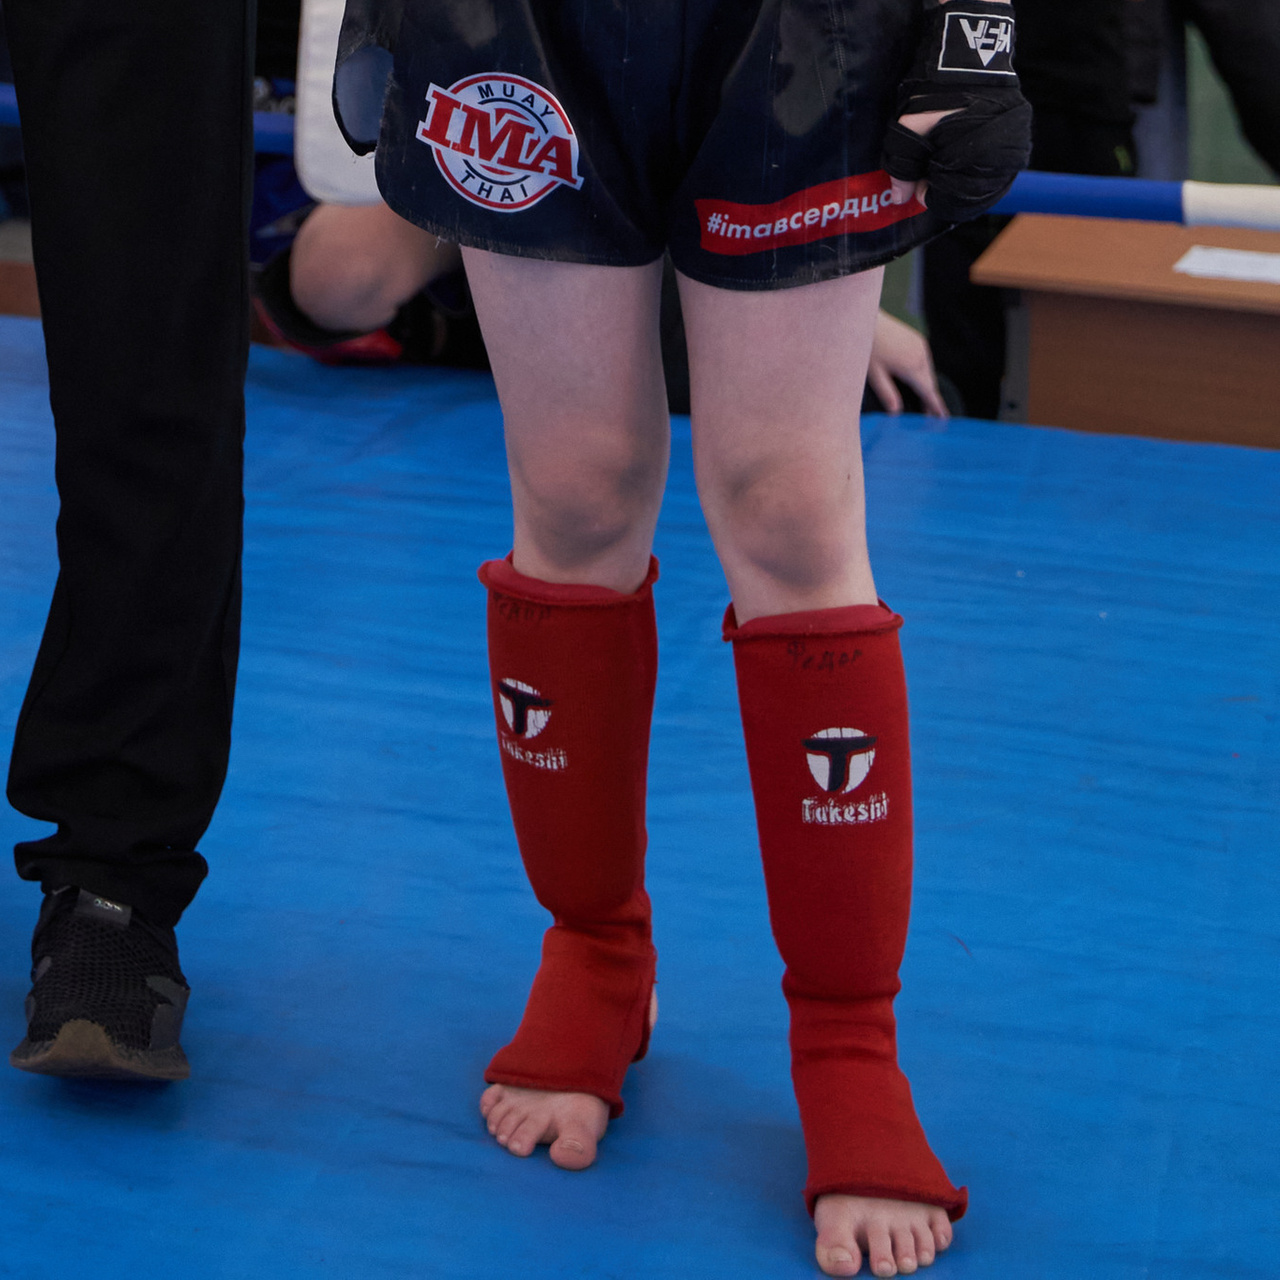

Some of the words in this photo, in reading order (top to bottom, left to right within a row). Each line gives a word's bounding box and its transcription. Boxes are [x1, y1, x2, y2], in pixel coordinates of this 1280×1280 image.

[477, 83, 555, 118] MUAY
[421, 90, 578, 185] IMA
[460, 169, 528, 202] THAI
[802, 791, 890, 826] Takeshi
